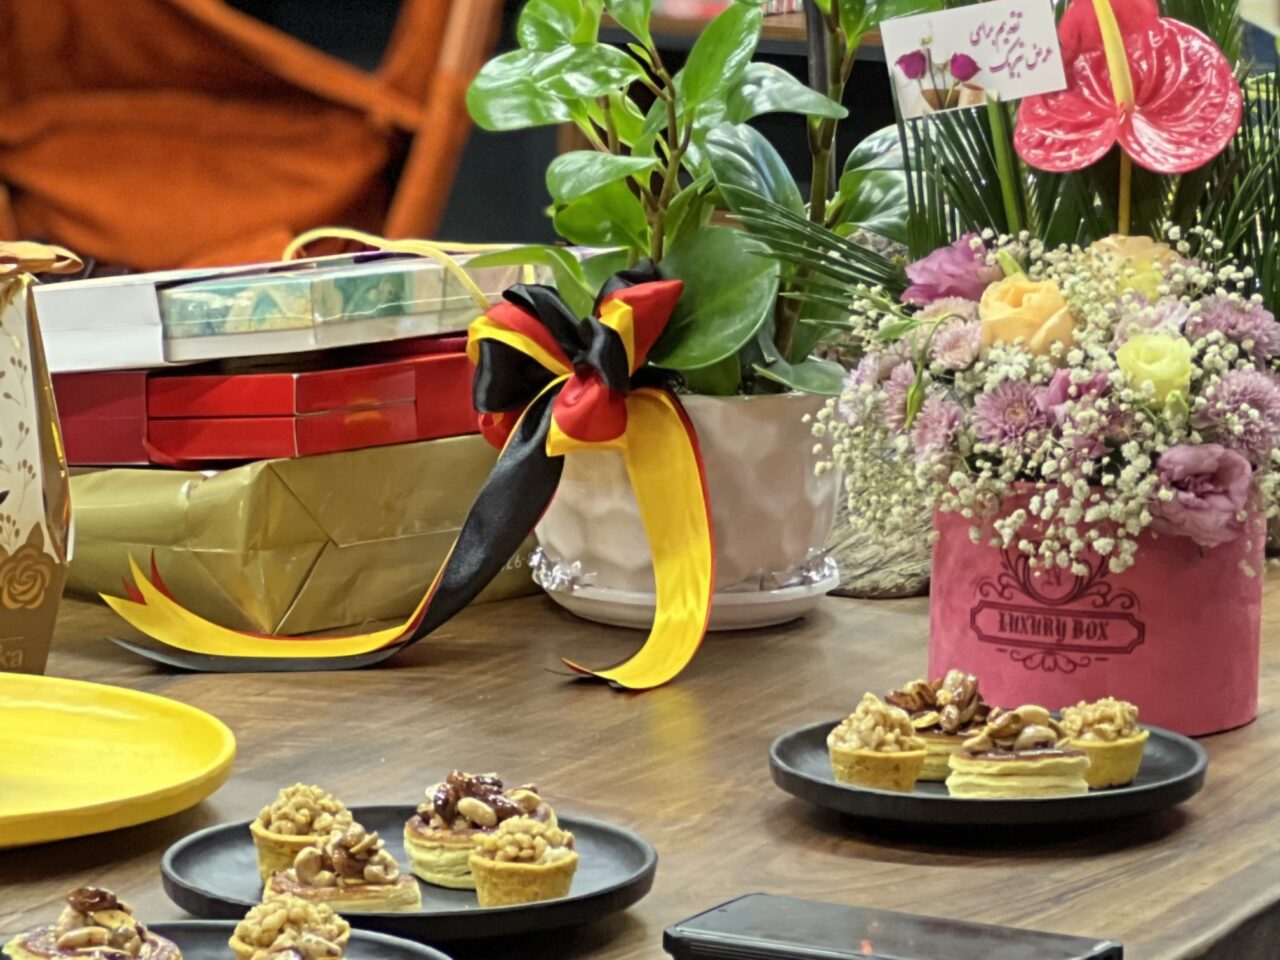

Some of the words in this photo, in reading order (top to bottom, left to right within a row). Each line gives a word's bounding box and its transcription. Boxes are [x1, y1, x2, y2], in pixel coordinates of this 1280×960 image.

[969, 21, 996, 47] برای
[995, 10, 1024, 52] تقدیم
[1072, 618, 1109, 641] BOX
